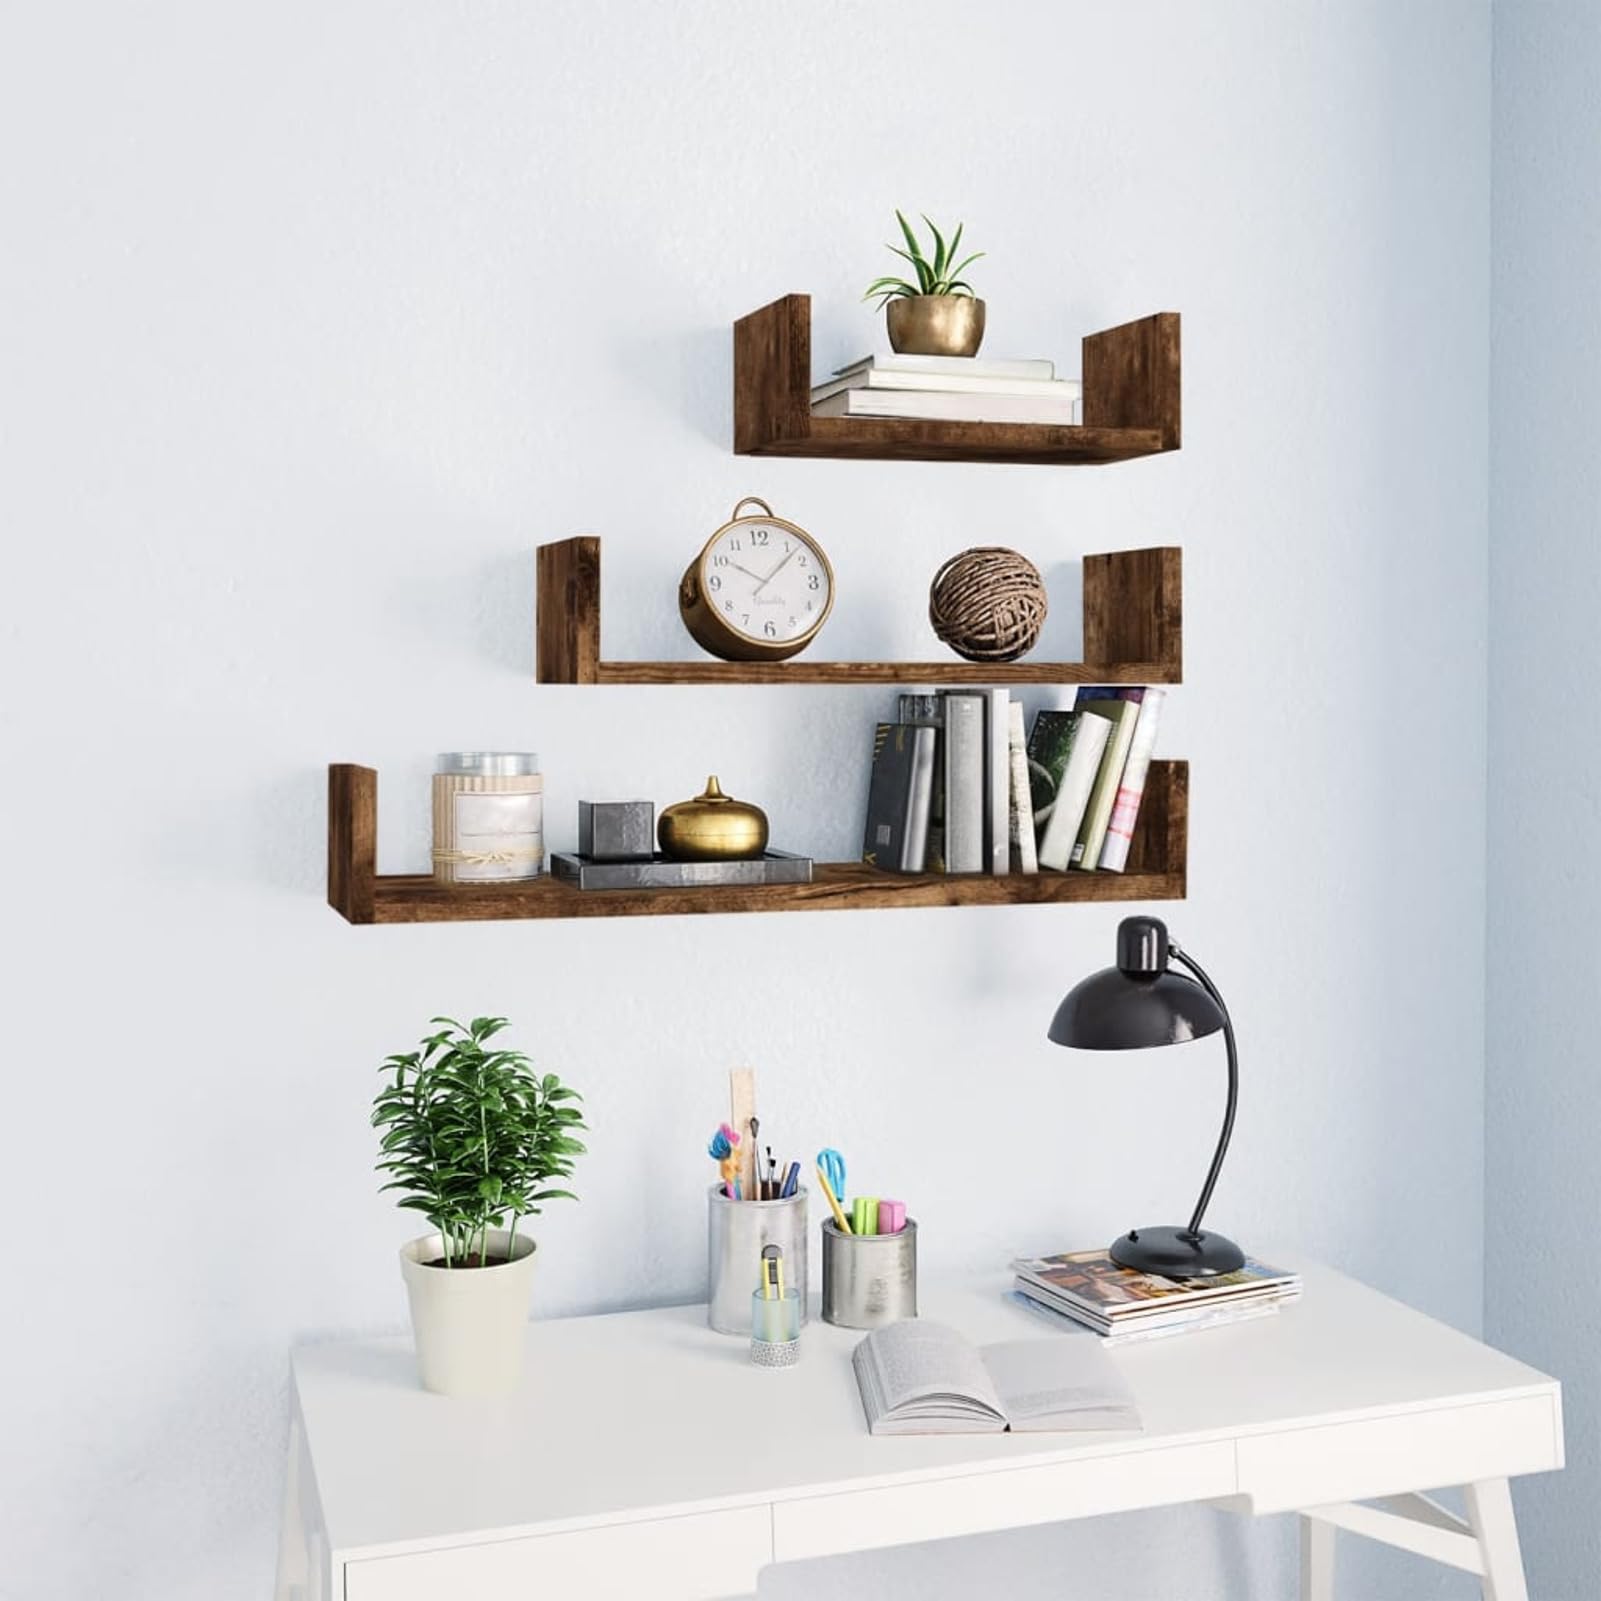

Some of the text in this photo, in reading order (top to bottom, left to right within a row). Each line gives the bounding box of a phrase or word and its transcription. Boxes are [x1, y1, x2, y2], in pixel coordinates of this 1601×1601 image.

[750, 531, 769, 546] 12
[731, 540, 741, 551] 11
[713, 556, 728, 567] 10
[799, 555, 807, 567] 2
[710, 576, 721, 591] 9
[809, 576, 819, 590] 3
[725, 601, 733, 611] 8
[742, 614, 750, 625] 7
[788, 616, 796, 626] 5
[764, 622, 776, 636] 6
